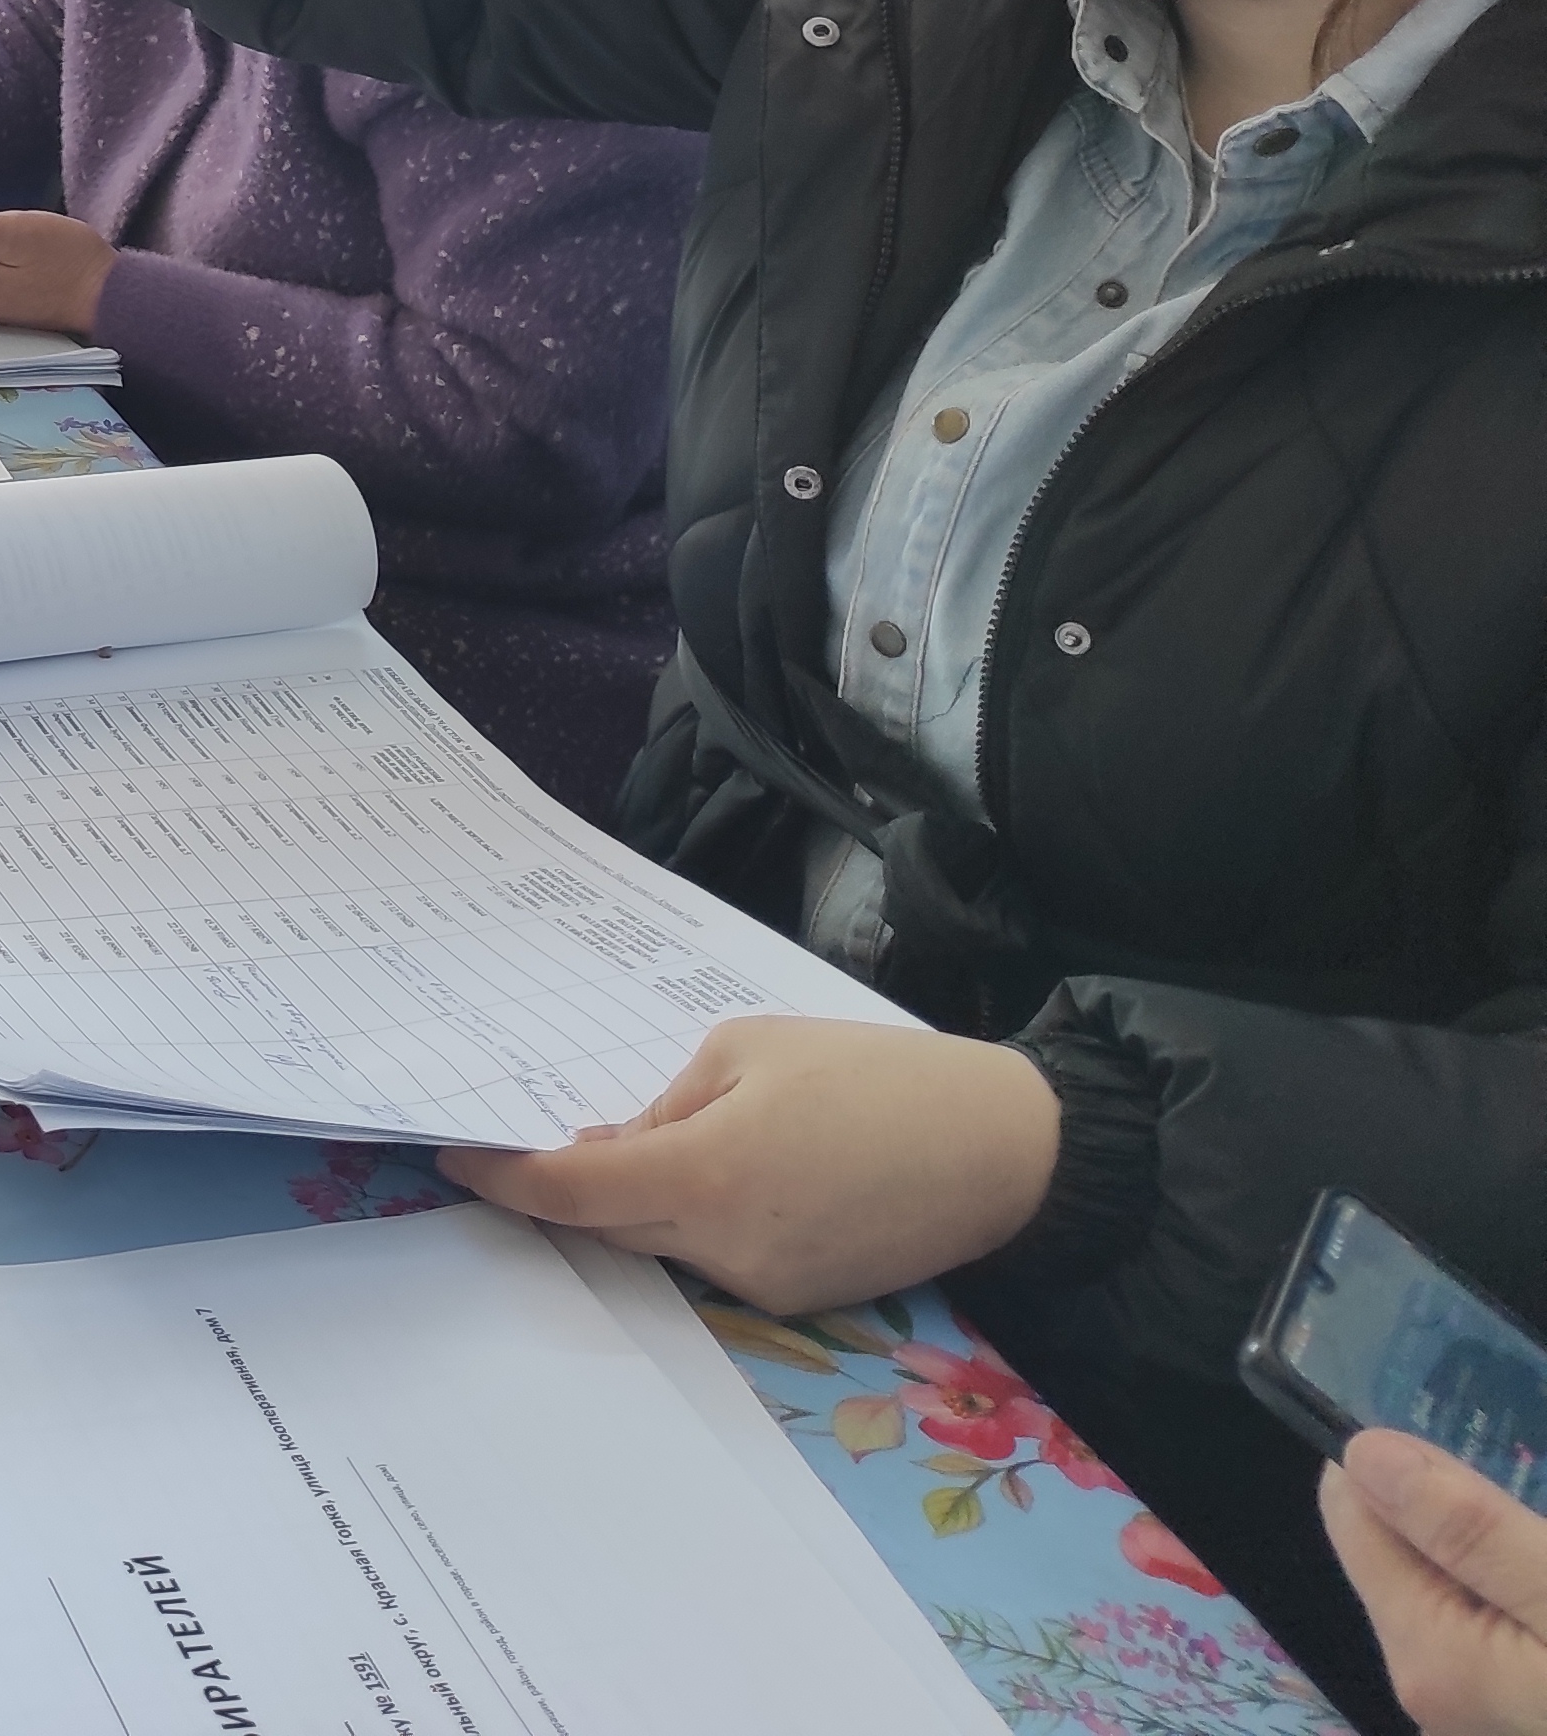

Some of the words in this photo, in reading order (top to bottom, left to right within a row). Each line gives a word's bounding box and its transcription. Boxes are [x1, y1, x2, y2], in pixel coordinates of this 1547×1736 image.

[194, 1306, 214, 1318] 7
[206, 1316, 234, 1345] дом
[224, 1345, 299, 1452] Кооперативная,
[291, 1452, 331, 1499] улица
[320, 1498, 357, 1547] Горка,
[349, 1548, 399, 1611] Красная
[392, 1612, 409, 1628] с.
[475, 1607, 502, 1635] район
[403, 1629, 442, 1680] округ,
[495, 1634, 519, 1665] город,
[348, 1651, 389, 1692] 1591
[516, 1664, 544, 1697] район,
[375, 1694, 398, 1716] №
